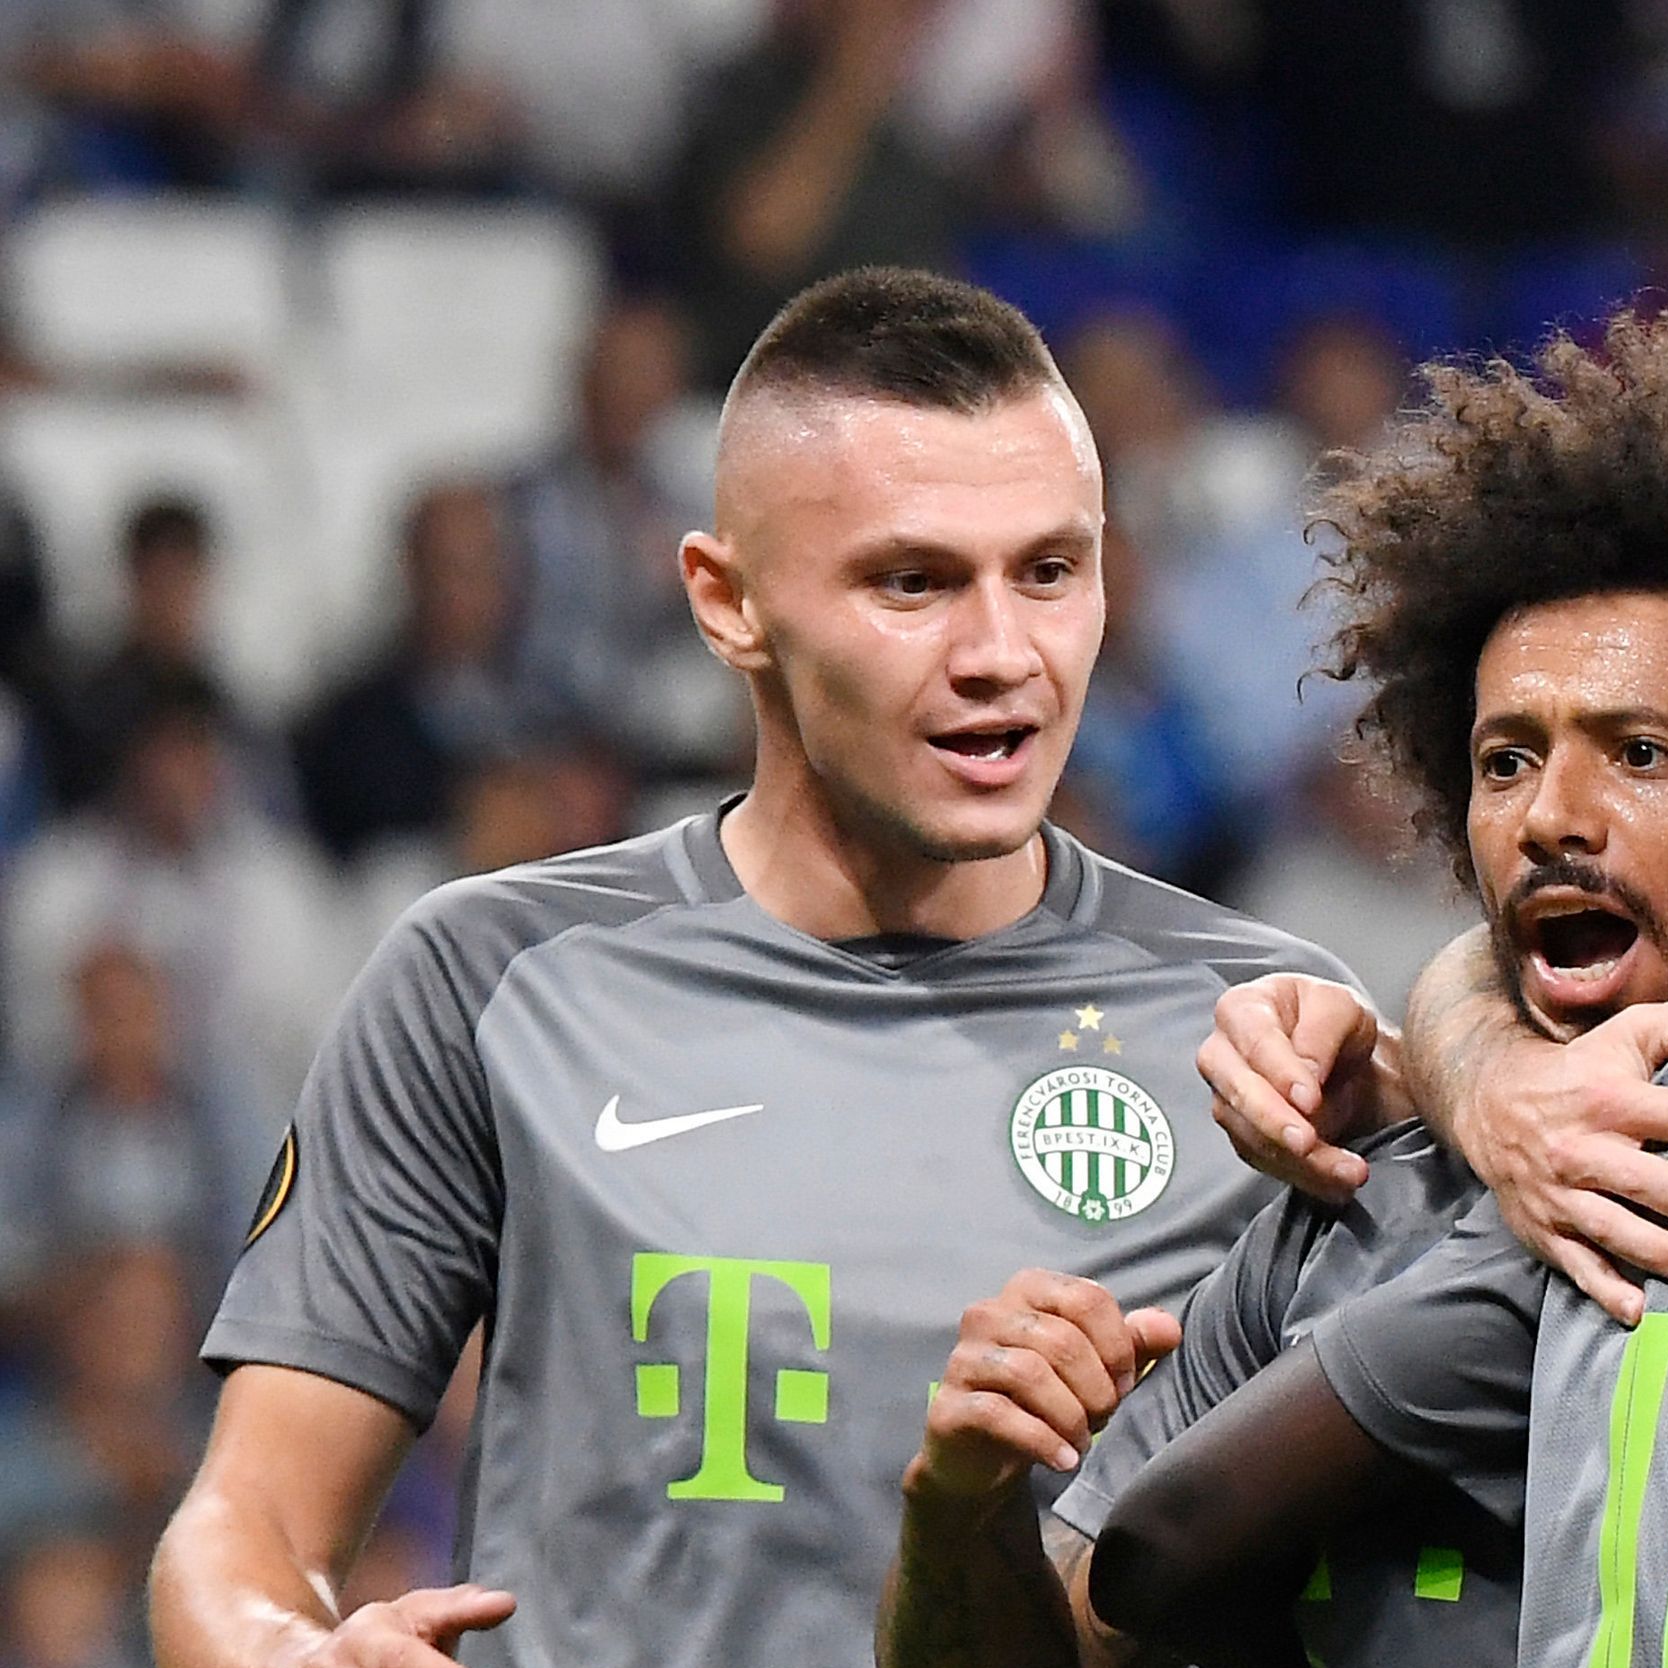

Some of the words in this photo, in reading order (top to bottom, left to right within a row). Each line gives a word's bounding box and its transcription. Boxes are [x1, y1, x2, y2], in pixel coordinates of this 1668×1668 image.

[1019, 1072, 1098, 1161] FERENCVÁROSI
[1105, 1075, 1159, 1126] TORNA
[1154, 1130, 1171, 1177] CLUB
[1054, 1190, 1073, 1209] 18
[1113, 1198, 1134, 1216] 99
[632, 1252, 832, 1502] T
